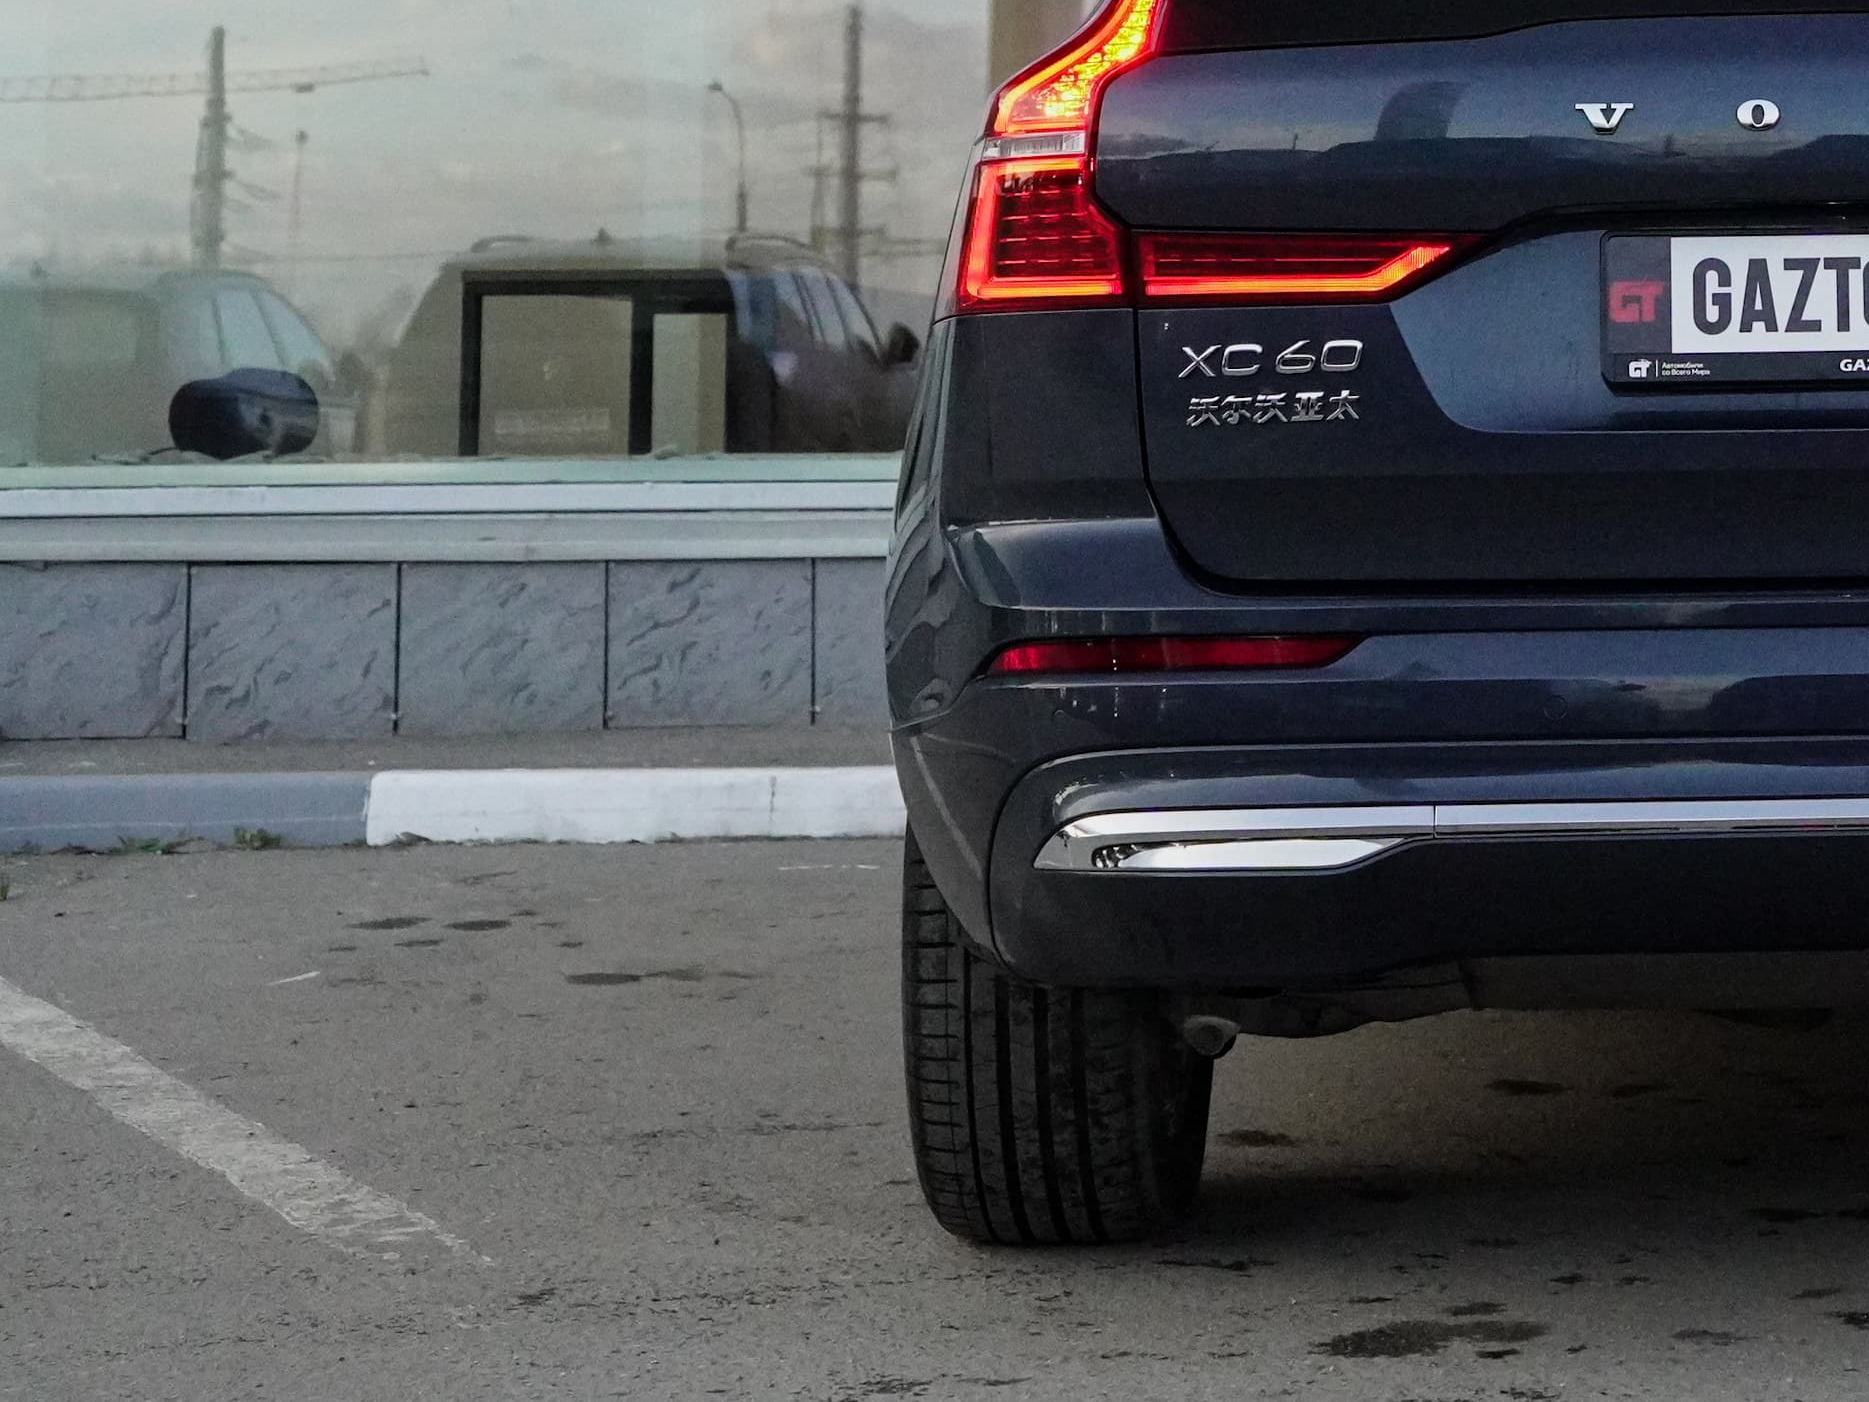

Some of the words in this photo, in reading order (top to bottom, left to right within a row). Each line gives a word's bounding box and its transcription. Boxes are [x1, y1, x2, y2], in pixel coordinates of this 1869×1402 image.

[1186, 389, 1359, 427] 沃尔沃亚太
